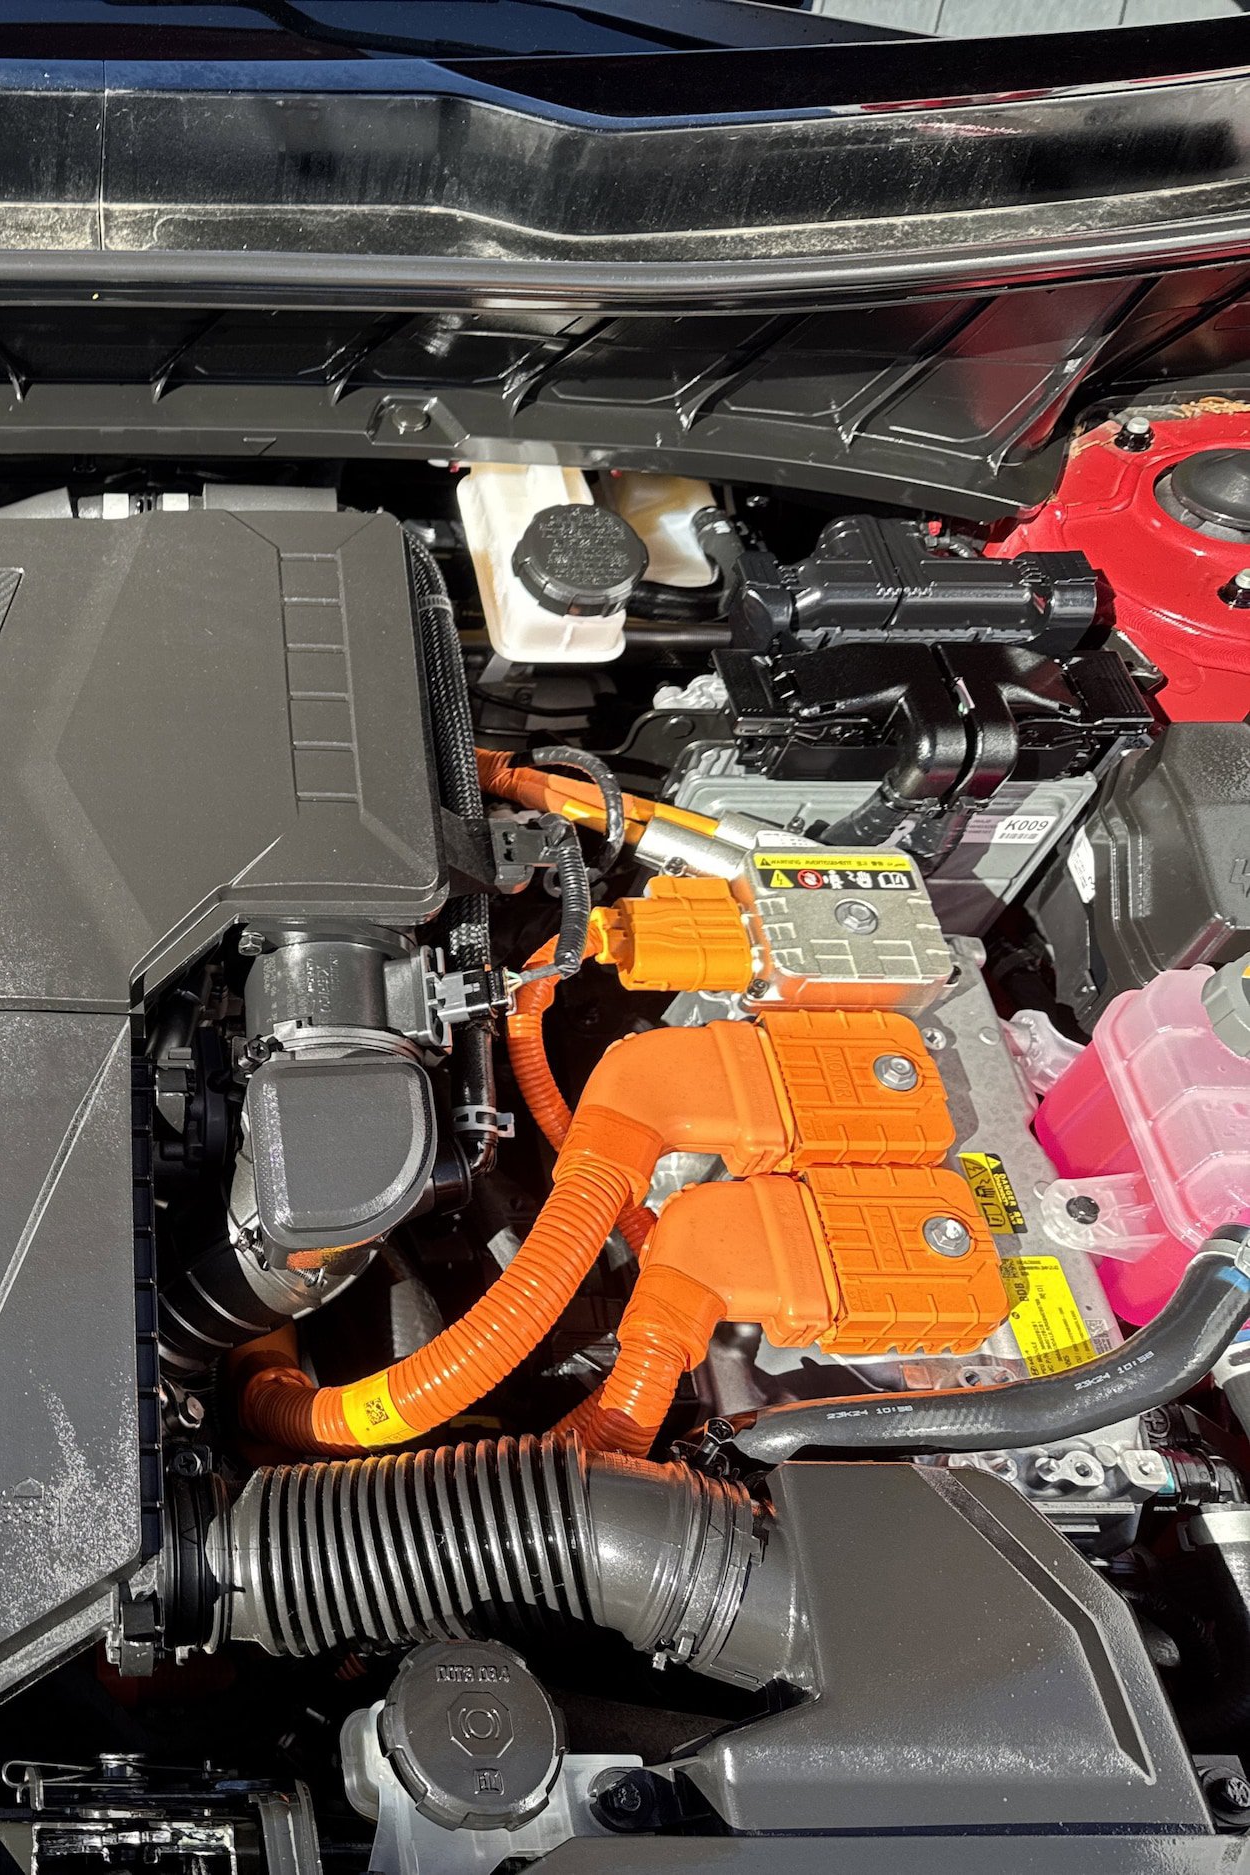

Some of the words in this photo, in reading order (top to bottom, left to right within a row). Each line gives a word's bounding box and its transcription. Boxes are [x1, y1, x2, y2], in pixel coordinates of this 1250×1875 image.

[1005, 820, 1049, 832] K009
[824, 1051, 851, 1097] MOTOR
[999, 1173, 1017, 1207] DANGER
